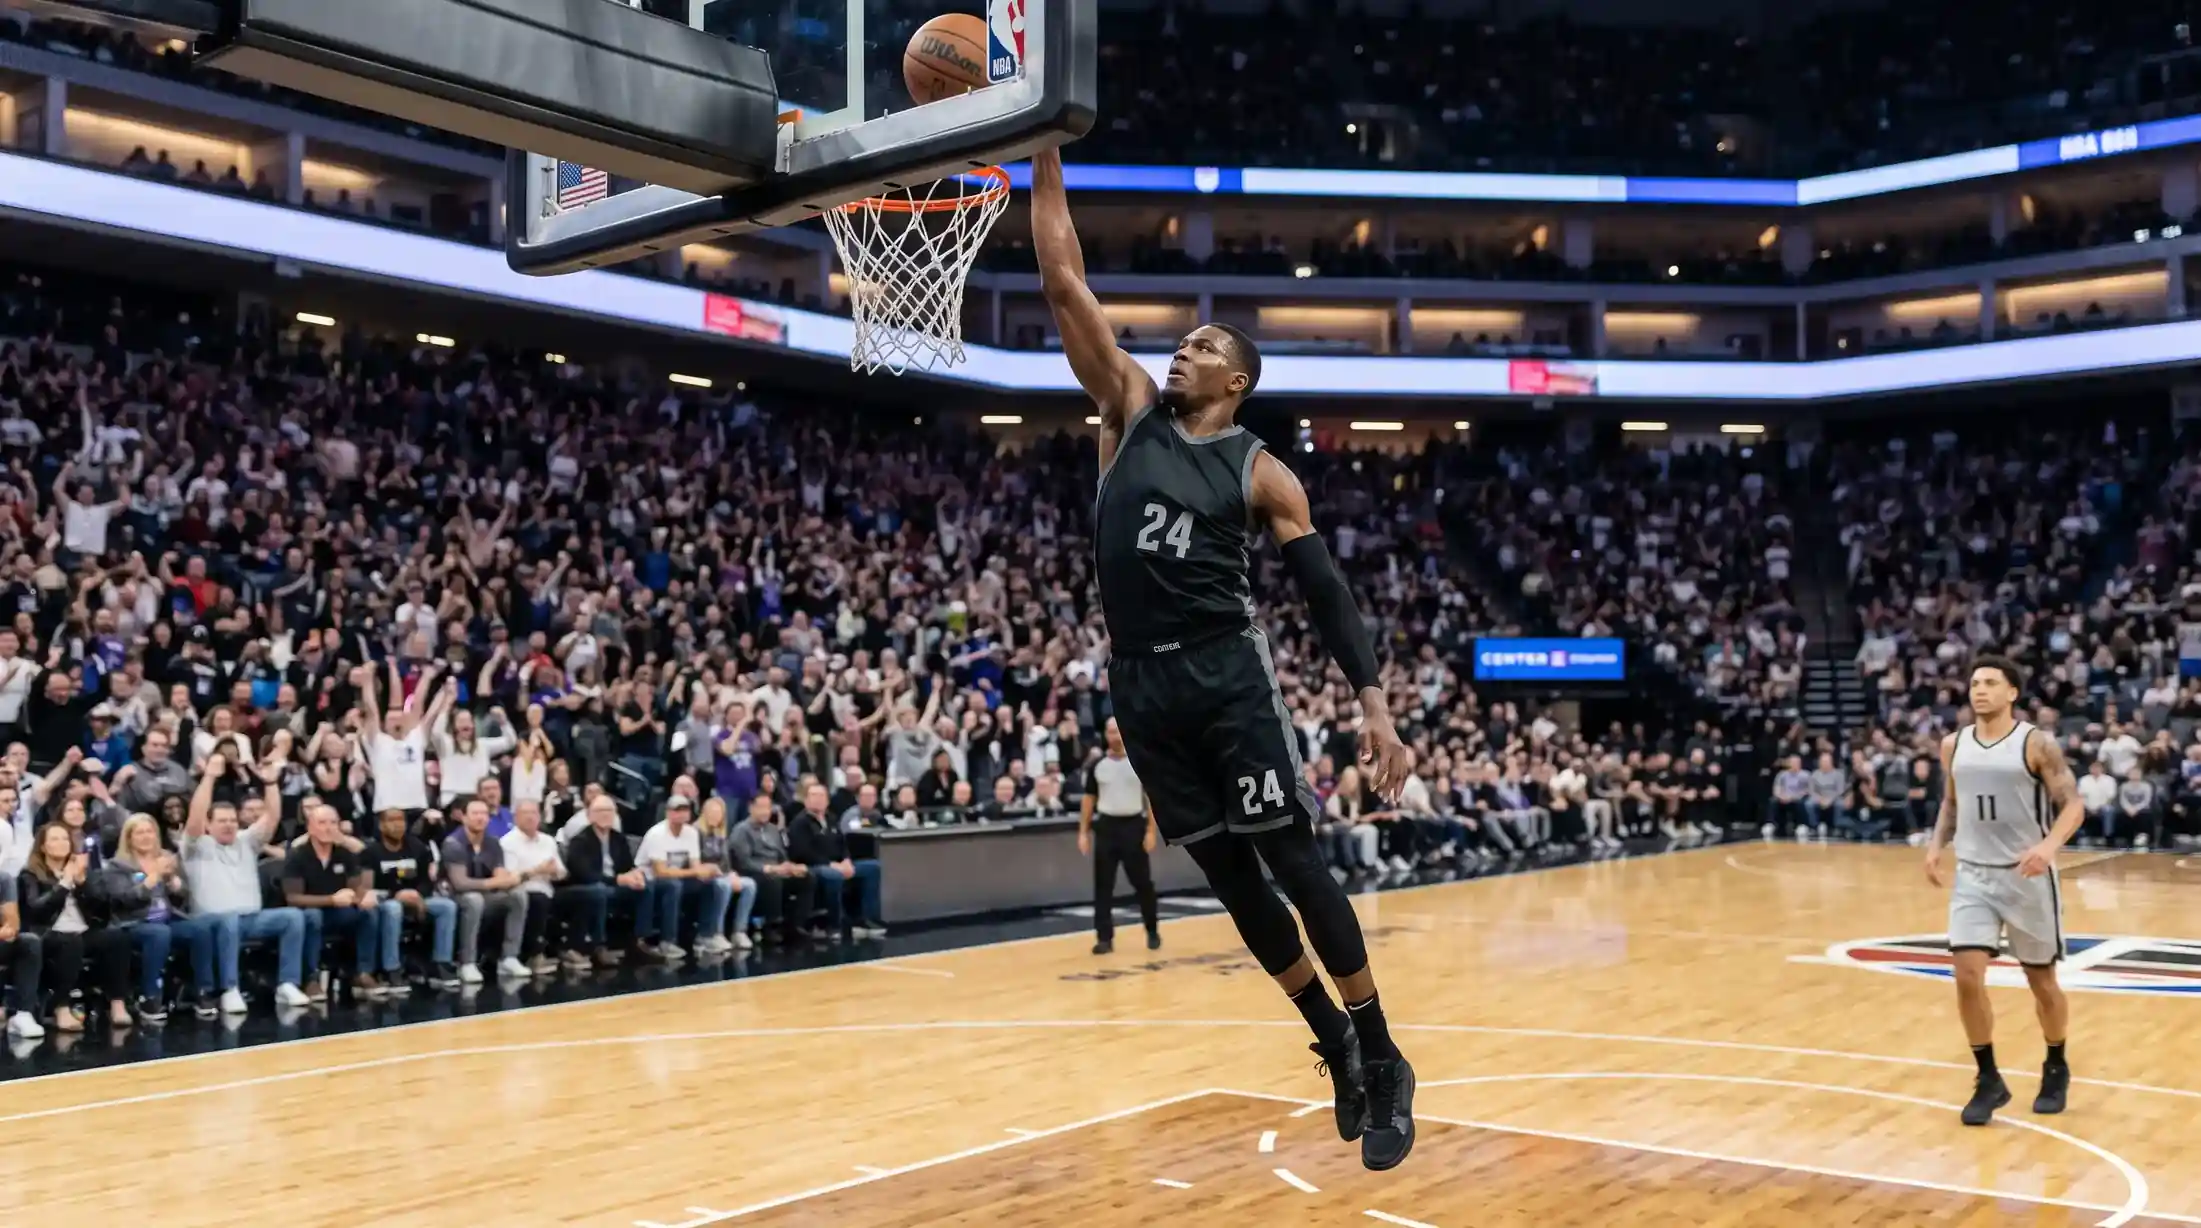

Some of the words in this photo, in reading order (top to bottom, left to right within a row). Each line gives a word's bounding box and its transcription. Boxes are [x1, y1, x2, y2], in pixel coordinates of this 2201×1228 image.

[920, 36, 982, 77] Wilson
[992, 57, 1012, 76] NBA
[1136, 502, 1194, 559] 24
[1237, 768, 1285, 816] 24
[1976, 794, 1997, 821] 11
